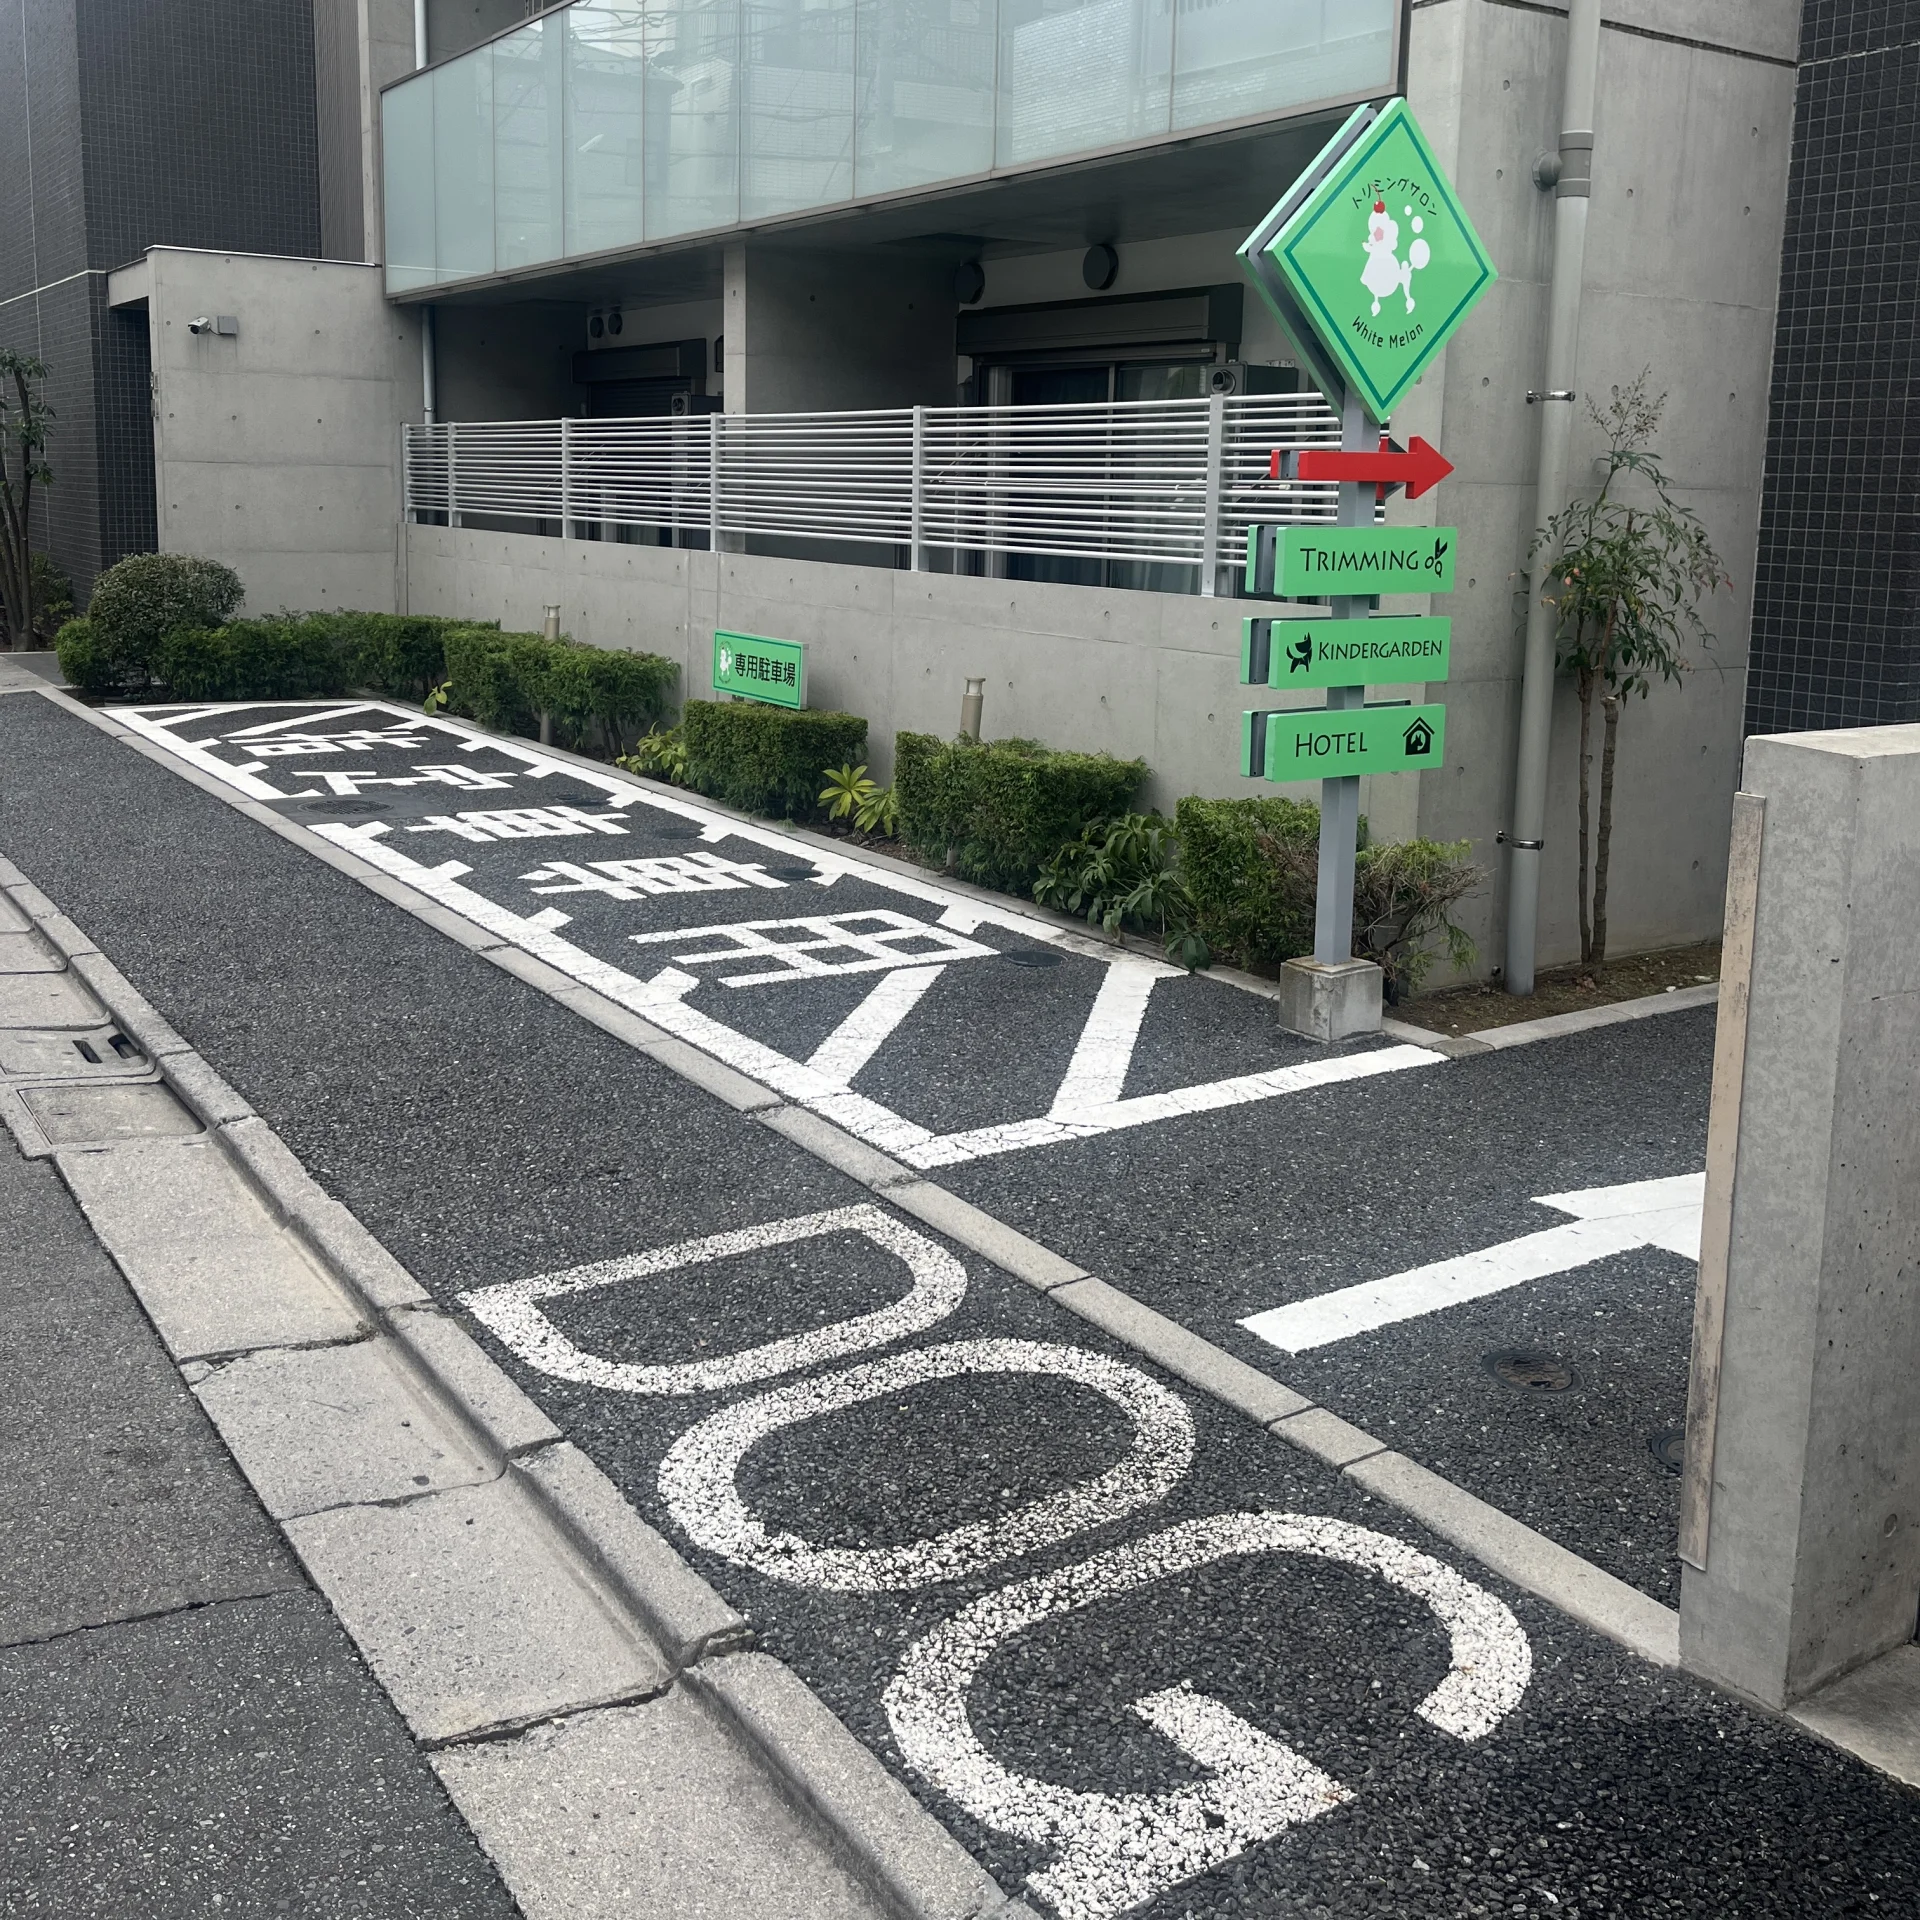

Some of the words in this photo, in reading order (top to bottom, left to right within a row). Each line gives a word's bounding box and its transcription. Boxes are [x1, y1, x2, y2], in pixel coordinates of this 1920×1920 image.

[1352, 178, 1437, 216] トリミングサロン
[1352, 315, 1384, 348] White
[1389, 323, 1424, 349] Melon
[1300, 547, 1418, 573] TRIMMING
[1318, 640, 1443, 661] KINDERGARDEN
[734, 652, 796, 687] 専用駐車場
[1296, 732, 1368, 758] HOTEL
[457, 1203, 1533, 1920] DOG
